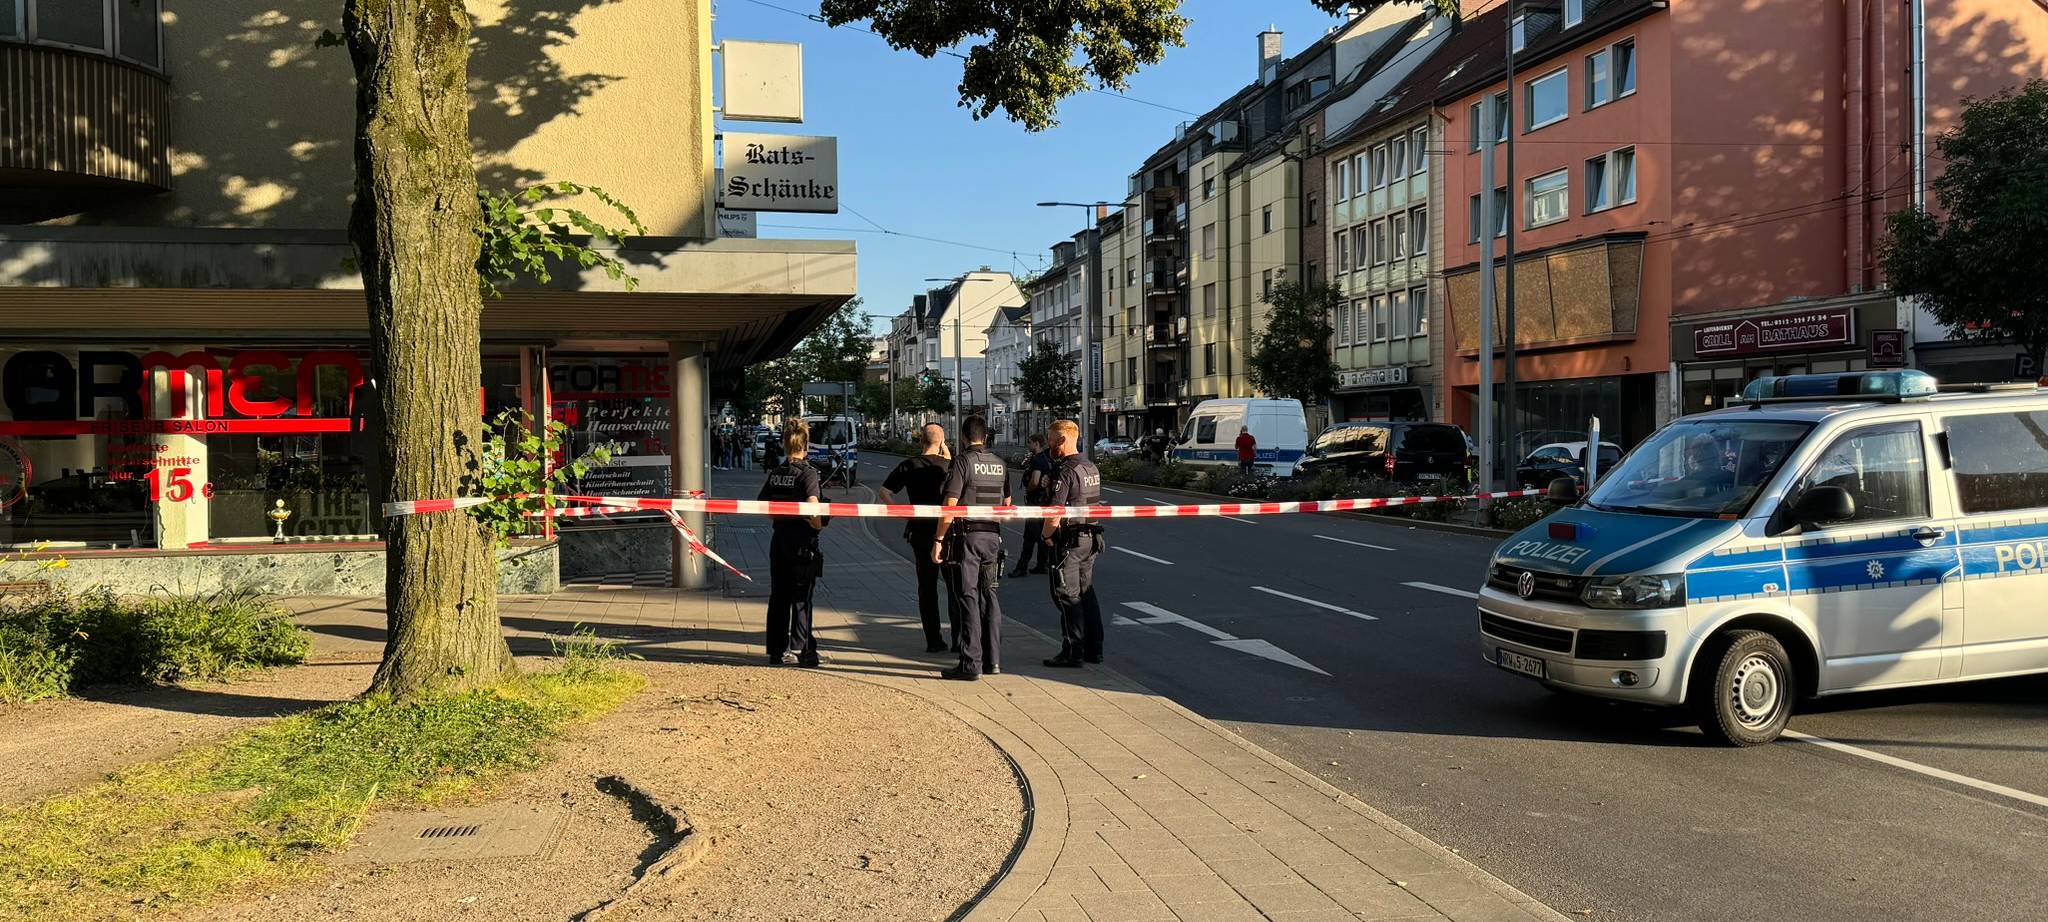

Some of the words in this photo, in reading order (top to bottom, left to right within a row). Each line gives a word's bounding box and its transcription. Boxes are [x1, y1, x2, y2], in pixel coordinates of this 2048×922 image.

[745, 143, 815, 165] Rats-
[728, 175, 834, 202] Schänke
[1703, 334, 1733, 348] GRILL
[1762, 323, 1829, 342] RATHAUS
[586, 405, 671, 420] Perfekte
[91, 421, 164, 433] FRISEUR
[172, 420, 229, 433] SALON
[586, 420, 671, 433] Haarschnitte
[974, 463, 1003, 476] POLIZEI
[144, 468, 194, 502] 15
[585, 479, 655, 489] Kinderhaarschnitt
[770, 475, 795, 487] POLIZEI
[1508, 541, 1590, 563] POLIZEI
